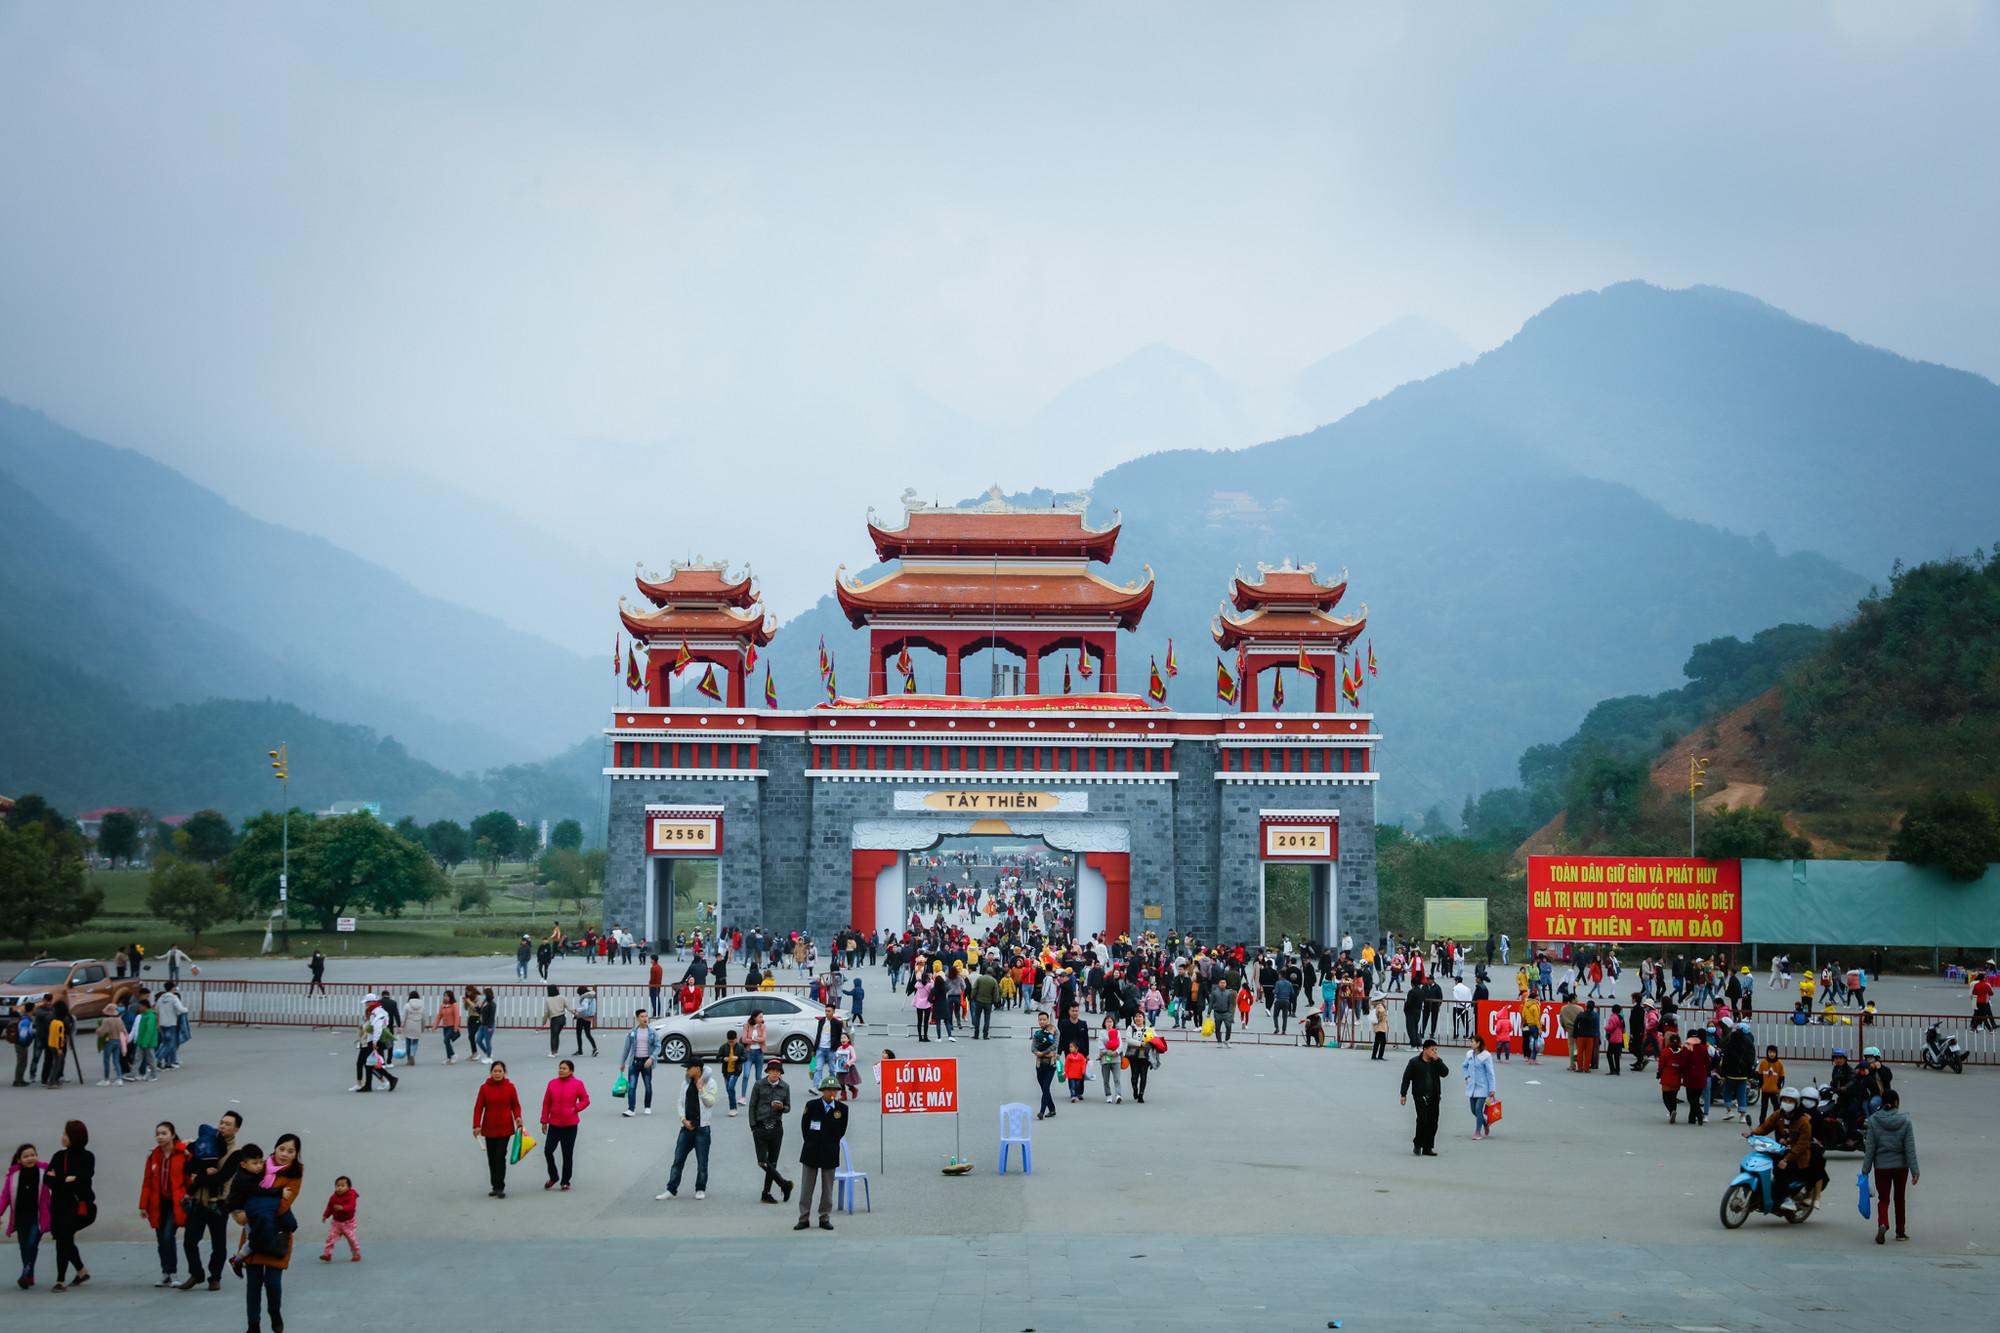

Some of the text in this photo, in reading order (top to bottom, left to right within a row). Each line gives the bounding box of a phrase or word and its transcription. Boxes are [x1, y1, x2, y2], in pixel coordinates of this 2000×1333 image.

[946, 791, 1037, 807] TÂY THIÊN
[665, 829, 704, 840] 2556
[1278, 836, 1316, 846] 2012
[1550, 862, 1718, 884] TOÀN DÂN GIỮ GÌN VÀ PHÁT HUY
[1533, 886, 1734, 914] GIÁ TRỊ KHU DI TÍCH QUỐC GIA ĐẶC BIỆT
[1545, 914, 1577, 936] TÂY
[1582, 915, 1632, 936] THIÊN
[1648, 918, 1684, 937] TAM
[1688, 913, 1724, 937] ĐẢO
[896, 1062, 941, 1083] LỐI VÀO
[885, 1086, 953, 1108] GỬI XE MÁY
